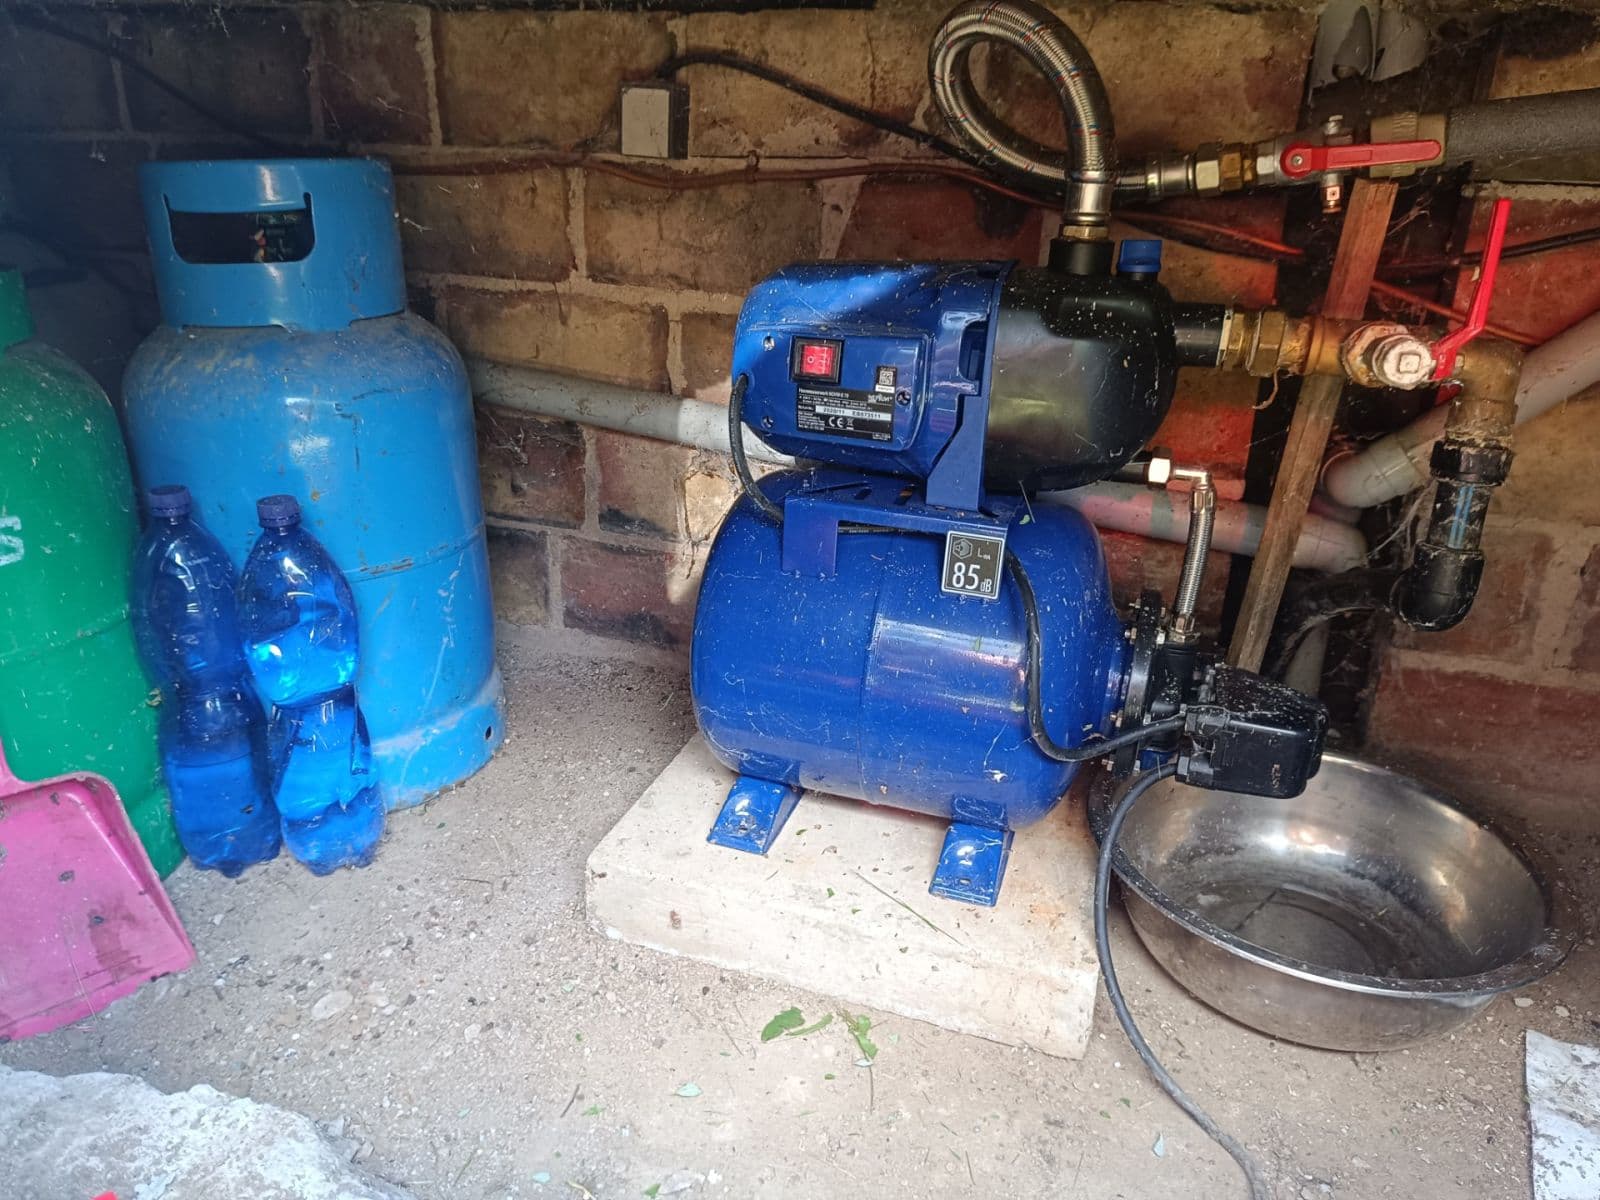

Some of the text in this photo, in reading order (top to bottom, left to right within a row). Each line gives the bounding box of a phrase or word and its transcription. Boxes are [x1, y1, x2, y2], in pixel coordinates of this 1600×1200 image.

[828, 416, 844, 428] CE
[952, 562, 993, 593] 85 dB
